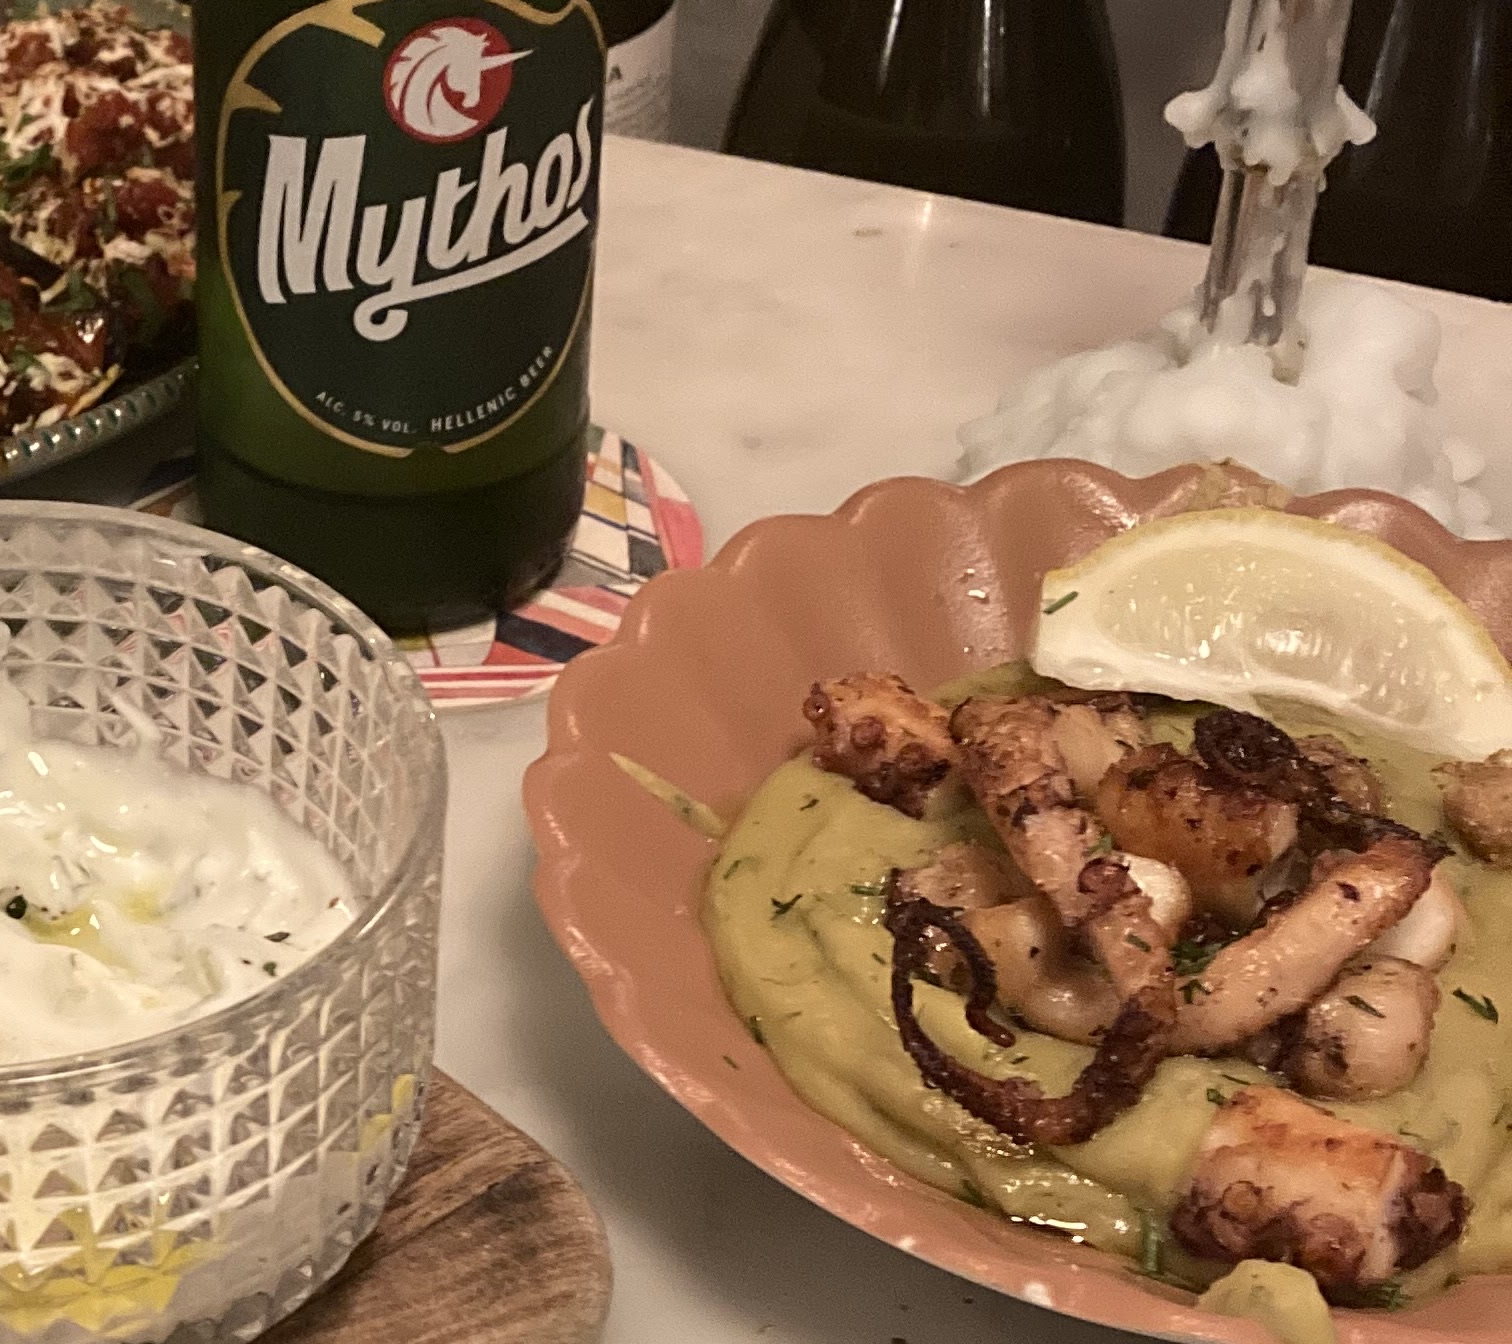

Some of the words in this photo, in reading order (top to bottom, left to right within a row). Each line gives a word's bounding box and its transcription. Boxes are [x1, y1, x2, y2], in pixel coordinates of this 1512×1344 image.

[258, 97, 595, 341] Mythos
[431, 386, 517, 433] HELLENIC
[520, 346, 553, 387] BEER
